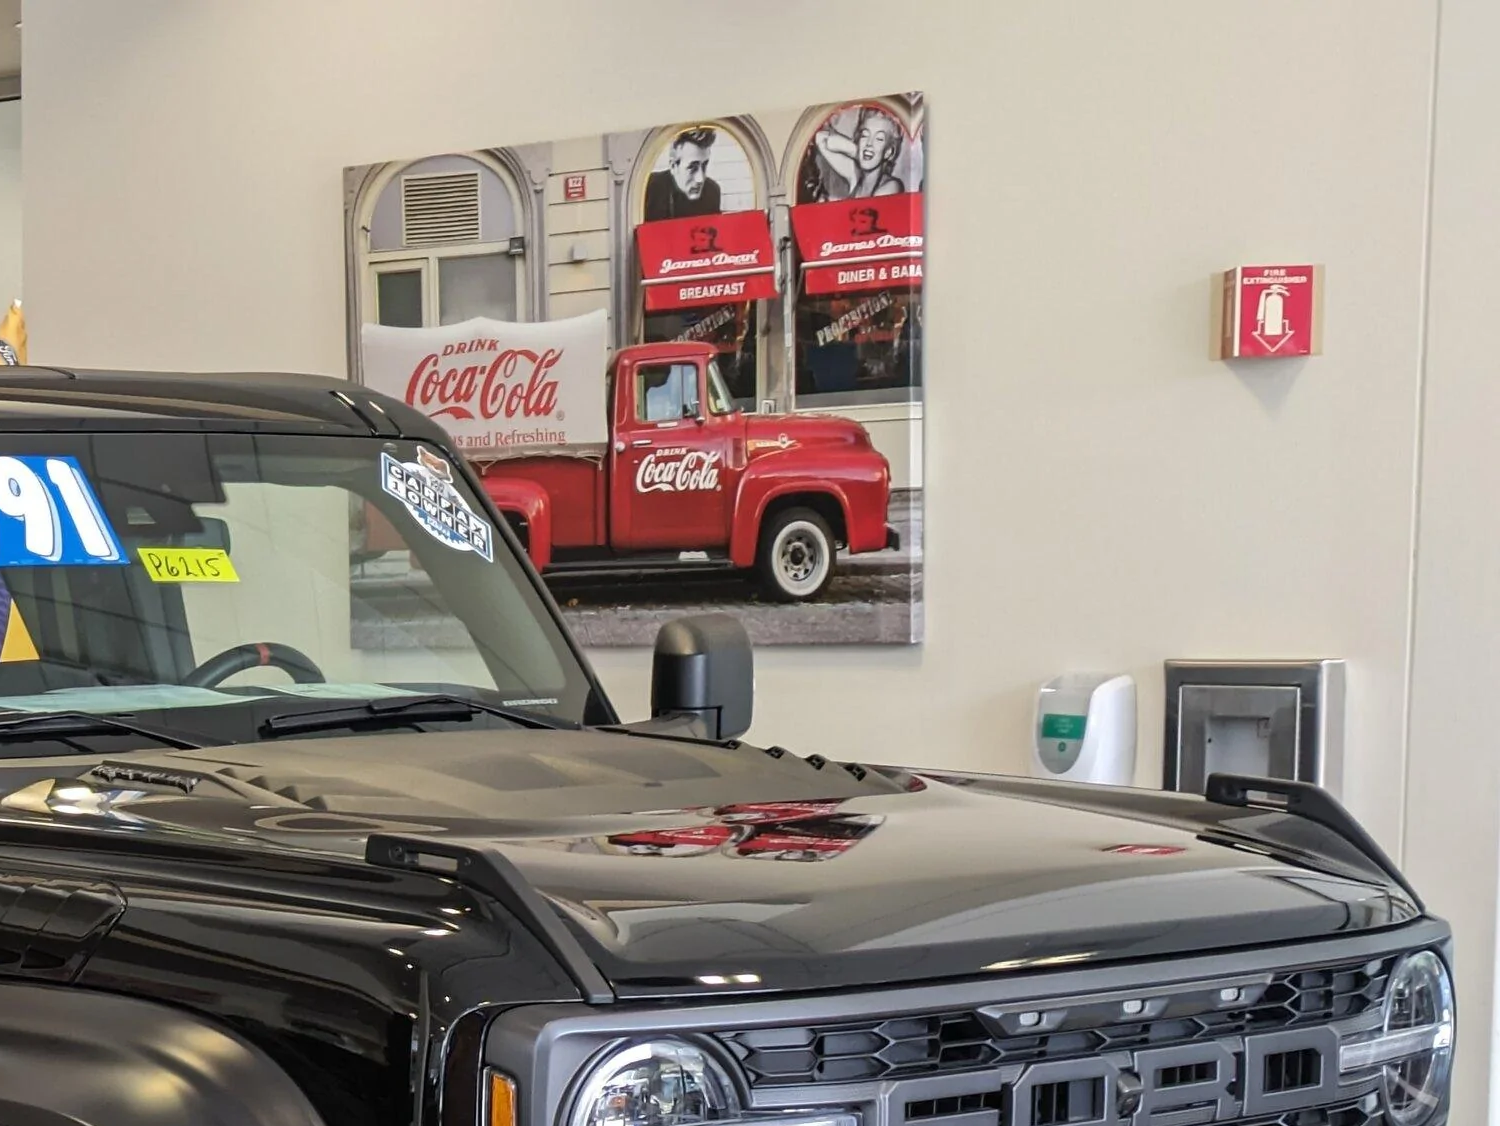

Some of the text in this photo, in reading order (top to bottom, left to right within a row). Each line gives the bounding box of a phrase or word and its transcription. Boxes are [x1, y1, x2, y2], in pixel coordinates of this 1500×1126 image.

[820, 241, 876, 257] James
[659, 250, 759, 273] James Dean
[837, 268, 875, 284] DINER
[879, 267, 888, 280] &
[1263, 269, 1287, 277] FIRE
[679, 282, 746, 301] BREAKFAST
[442, 338, 500, 357] DRINK
[405, 348, 565, 420] Coca-Cola
[466, 431, 490, 447] and
[495, 427, 566, 447] Refreshing
[636, 450, 722, 493] Coca-Cola
[389, 464, 486, 537] CARFAX
[407, 490, 486, 550] OWNER
